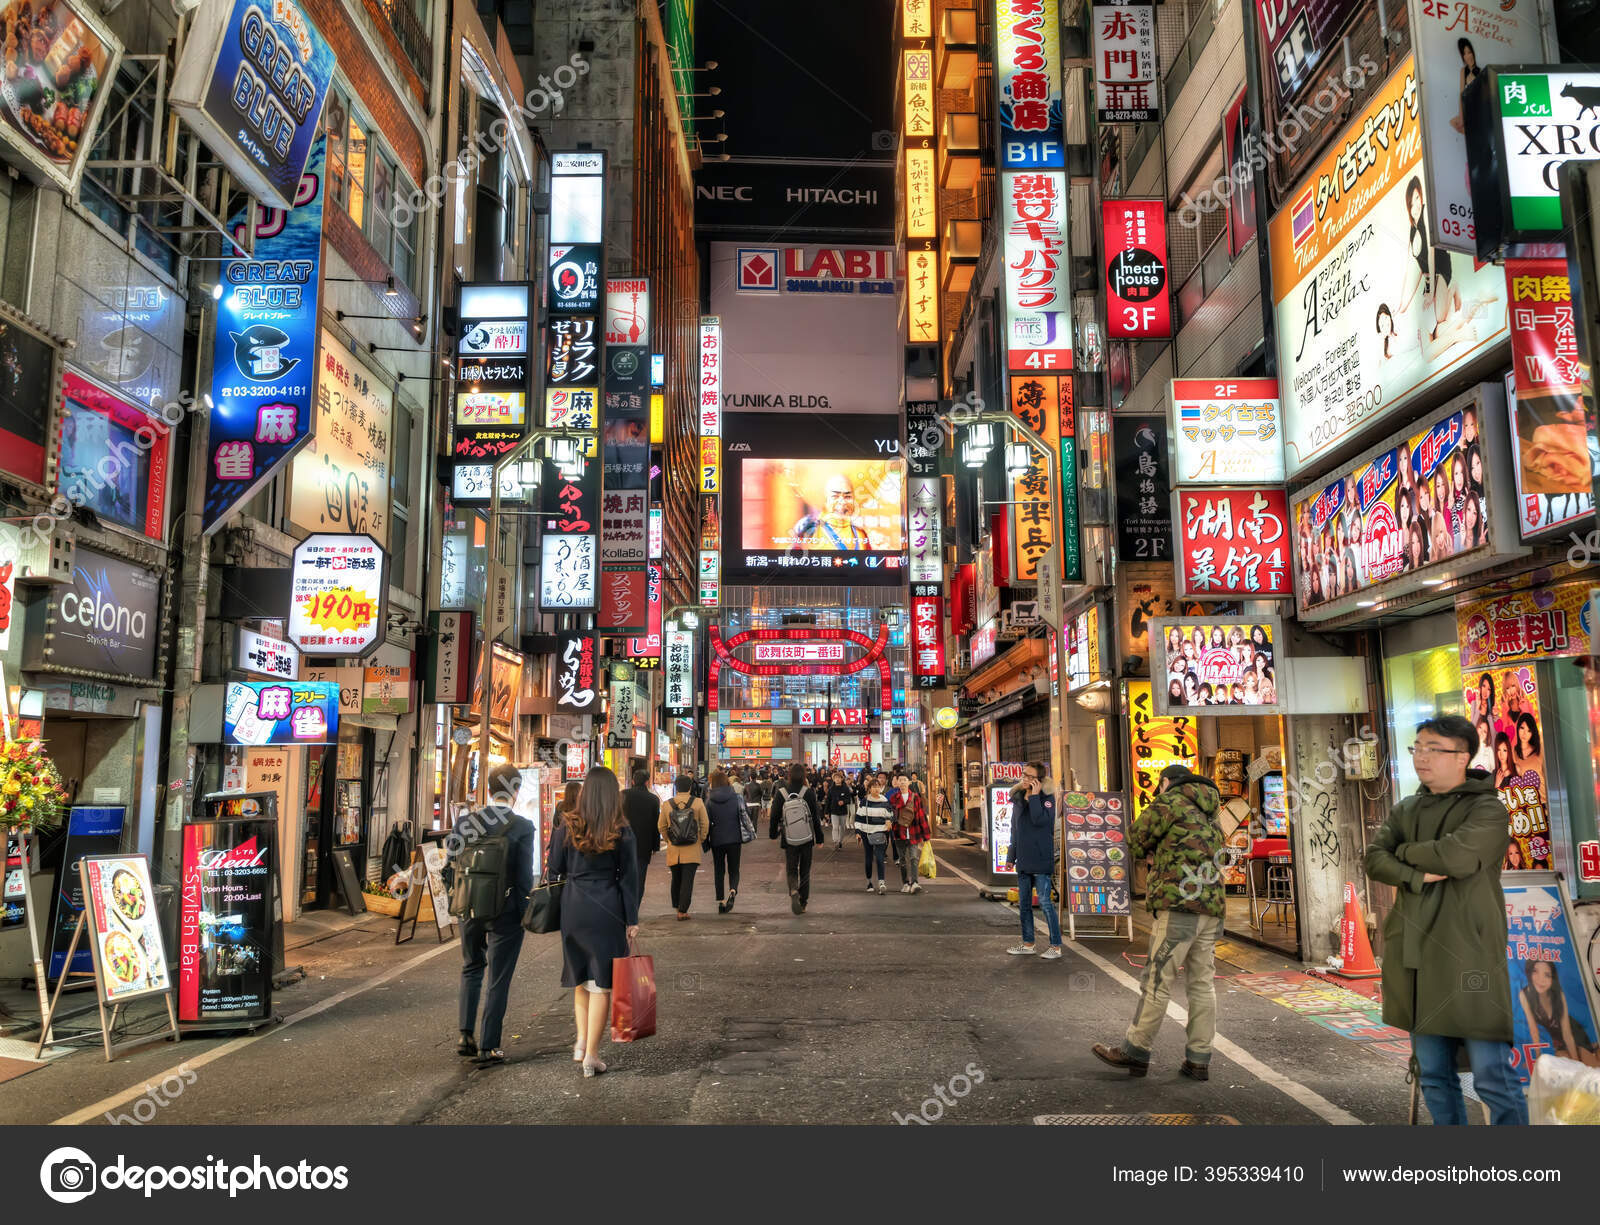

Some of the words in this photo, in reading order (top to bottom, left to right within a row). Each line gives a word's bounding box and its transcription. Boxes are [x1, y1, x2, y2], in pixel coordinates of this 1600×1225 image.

[920, 40, 926, 49] 7
[1101, 10, 1140, 80] 赤門
[1277, 17, 1307, 85] 3F
[241, 5, 316, 127] GREAT
[1503, 80, 1527, 105] 肉
[232, 60, 297, 161] BLUE
[907, 93, 931, 132] 魚金
[238, 129, 270, 167] グレイトブルー
[922, 140, 929, 149] 6
[1007, 142, 1058, 162] B1F
[696, 185, 753, 201] NEC
[785, 187, 878, 205] HITACHI
[910, 158, 926, 228] ちびすけバル
[1294, 238, 1320, 275] Thai
[1322, 156, 1391, 245] Traditional
[553, 250, 566, 258] 4F
[924, 241, 932, 251] 5
[226, 260, 314, 284] GREAT
[784, 248, 894, 280] LABI
[233, 284, 302, 308] BLUE
[607, 280, 647, 293] SHISHA
[1512, 275, 1572, 302] 肉祭
[1321, 273, 1371, 324] Relax
[242, 312, 292, 320] グレイトブルー
[1122, 307, 1156, 331] 3F
[494, 335, 521, 350] 酔月
[551, 320, 569, 382] ゼーション
[570, 320, 596, 382] リラク
[1024, 351, 1057, 369] 4F
[460, 366, 524, 381] 日本人セラピスト
[701, 334, 718, 427] お好み焼き
[233, 386, 307, 397] 03-3200-4181
[721, 393, 785, 408] YUNIKA
[788, 394, 832, 409] BLDG.
[1214, 384, 1238, 397] 2F
[463, 405, 511, 417] クアトロ
[1061, 382, 1075, 429] 炭火串焼
[1203, 402, 1276, 423] タイ古式
[1182, 422, 1277, 443] マッサージ
[1420, 417, 1458, 477] 即デート
[913, 463, 935, 473] 3F
[1134, 451, 1159, 515] 鳥物語
[1363, 454, 1391, 508] 話して
[1187, 491, 1285, 545] 湖南
[602, 530, 644, 542] サムギョプサル
[602, 548, 644, 558] KollaBo
[1135, 538, 1166, 557] 2F
[574, 535, 592, 592] 居酒屋
[1188, 546, 1263, 593] 菜館
[920, 573, 933, 581] 3F
[611, 573, 633, 627] ステップ
[915, 585, 938, 596] 焼肉
[60, 590, 146, 640] celona
[311, 594, 372, 621] 190円
[1486, 599, 1522, 621] すべて
[758, 645, 842, 659] 歌舞伎町一番街
[920, 676, 937, 687] 2F
[294, 691, 326, 703] フリー
[672, 707, 684, 715] 2F
[815, 709, 868, 725] LABI
[252, 756, 283, 768] 網焼き
[991, 763, 1023, 780] 19:00
[1136, 759, 1166, 768] COCO
[260, 772, 282, 784] 刺身
[196, 847, 269, 871] Real
[202, 885, 222, 895] Open
[222, 884, 244, 893] Hours
[1517, 942, 1563, 963] Relax
